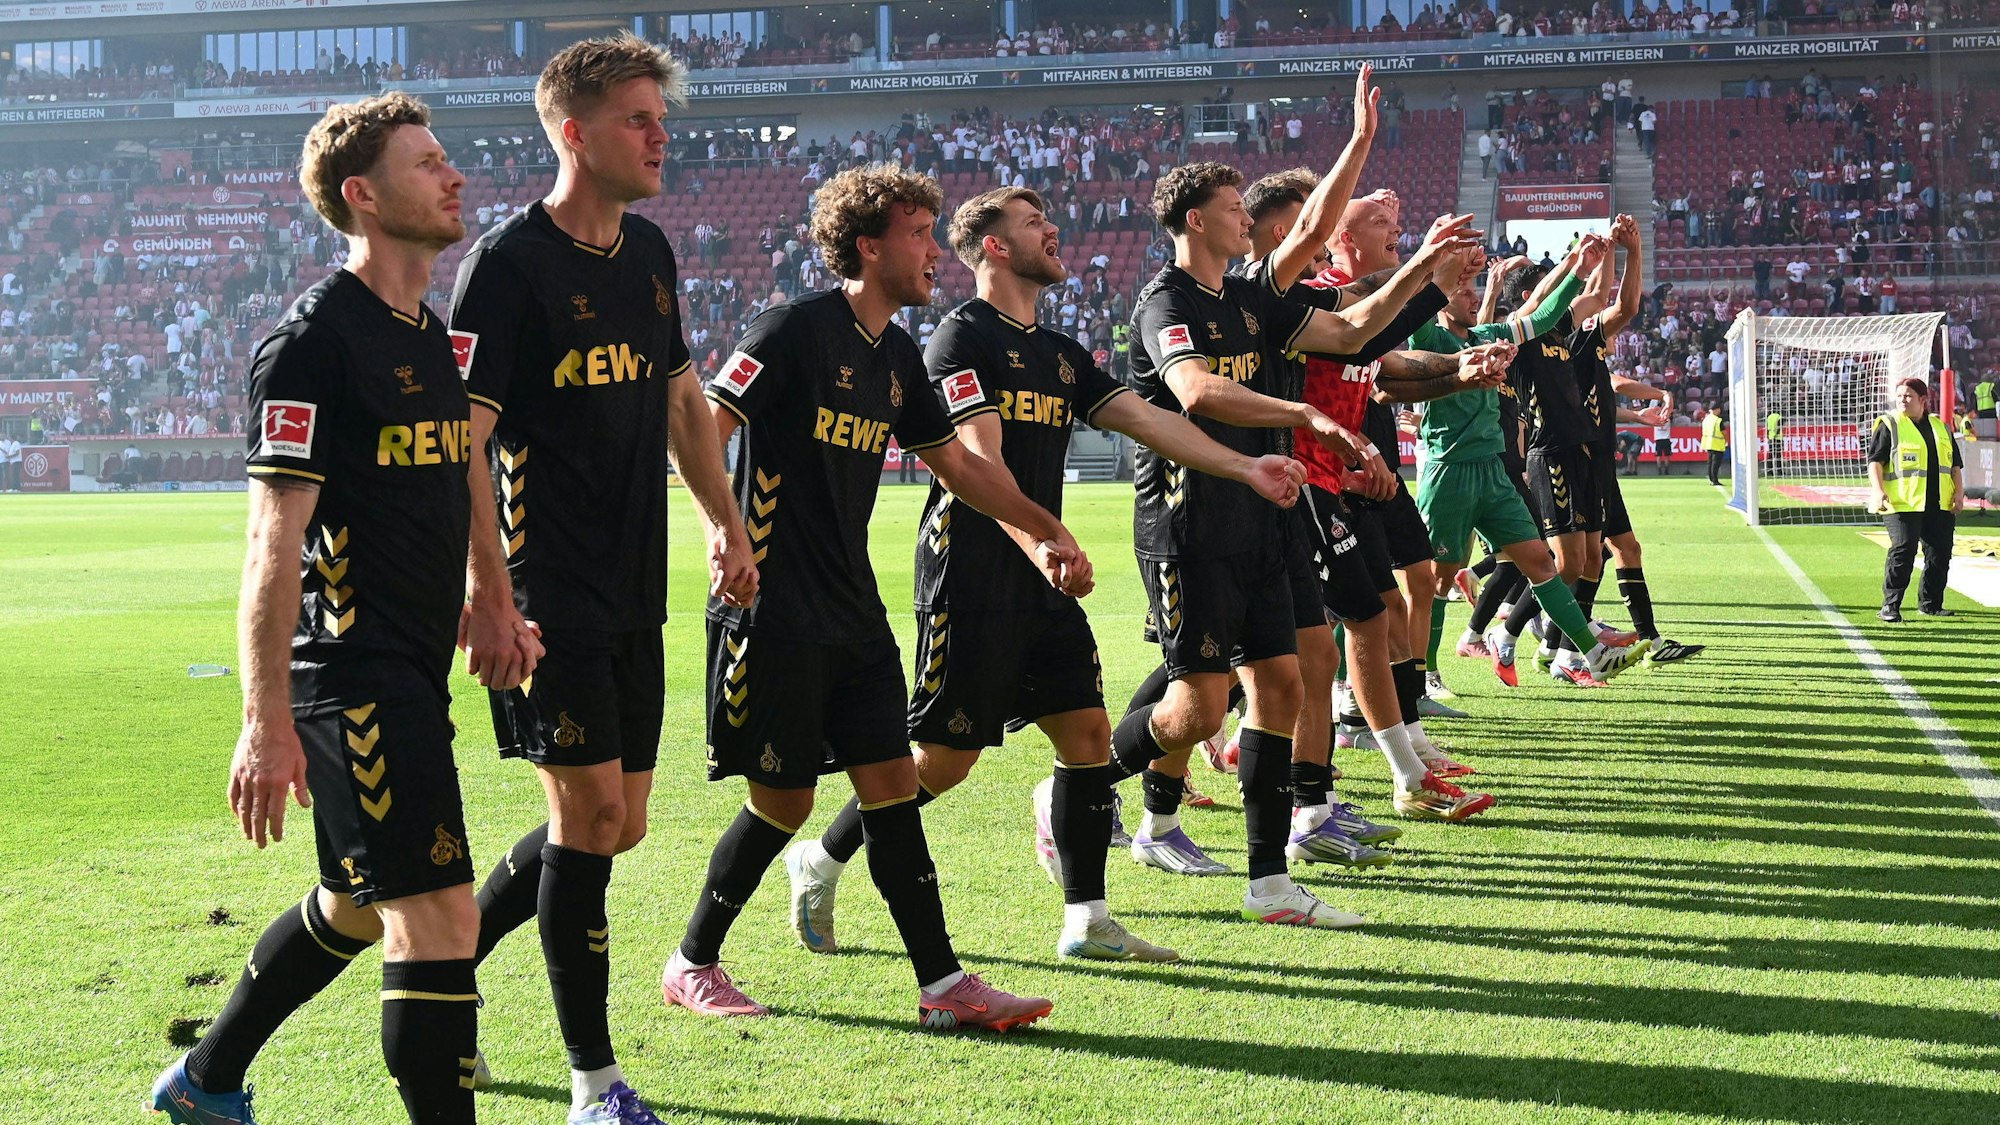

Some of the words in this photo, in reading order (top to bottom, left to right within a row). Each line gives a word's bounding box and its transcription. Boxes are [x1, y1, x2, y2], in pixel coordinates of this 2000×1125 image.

[1735, 44, 1799, 56] MAINZER
[1804, 38, 1878, 53] MOBILITÄT
[1484, 52, 1564, 65] MITFAHREN
[1567, 52, 1576, 62] &
[1580, 49, 1663, 62] MITFIEBERN
[1279, 60, 1340, 73] MAINZER
[1344, 57, 1415, 71] MOBILITÄT
[1043, 68, 1118, 82] MITFAHREN
[1122, 67, 1130, 79] &
[1133, 65, 1212, 79] MITFIEBERN
[701, 84, 710, 95] &
[713, 81, 787, 95] MITFIEBERN
[850, 77, 908, 89] MAINZER
[911, 73, 978, 87] MOBILITÄT
[446, 92, 500, 105] MAINZER
[26, 112, 34, 120] &
[37, 107, 105, 121] MITFIEBERN
[255, 103, 290, 113] ARENA
[1505, 191, 1604, 202] BAUUNTERNEHMUNG
[1527, 203, 1582, 213] GEMÜNDEN
[133, 235, 211, 251] GEMÜNDEN
[11, 392, 53, 404] MAINZ
[952, 395, 982, 409] BUNDESLIGA
[813, 406, 890, 454] REWE
